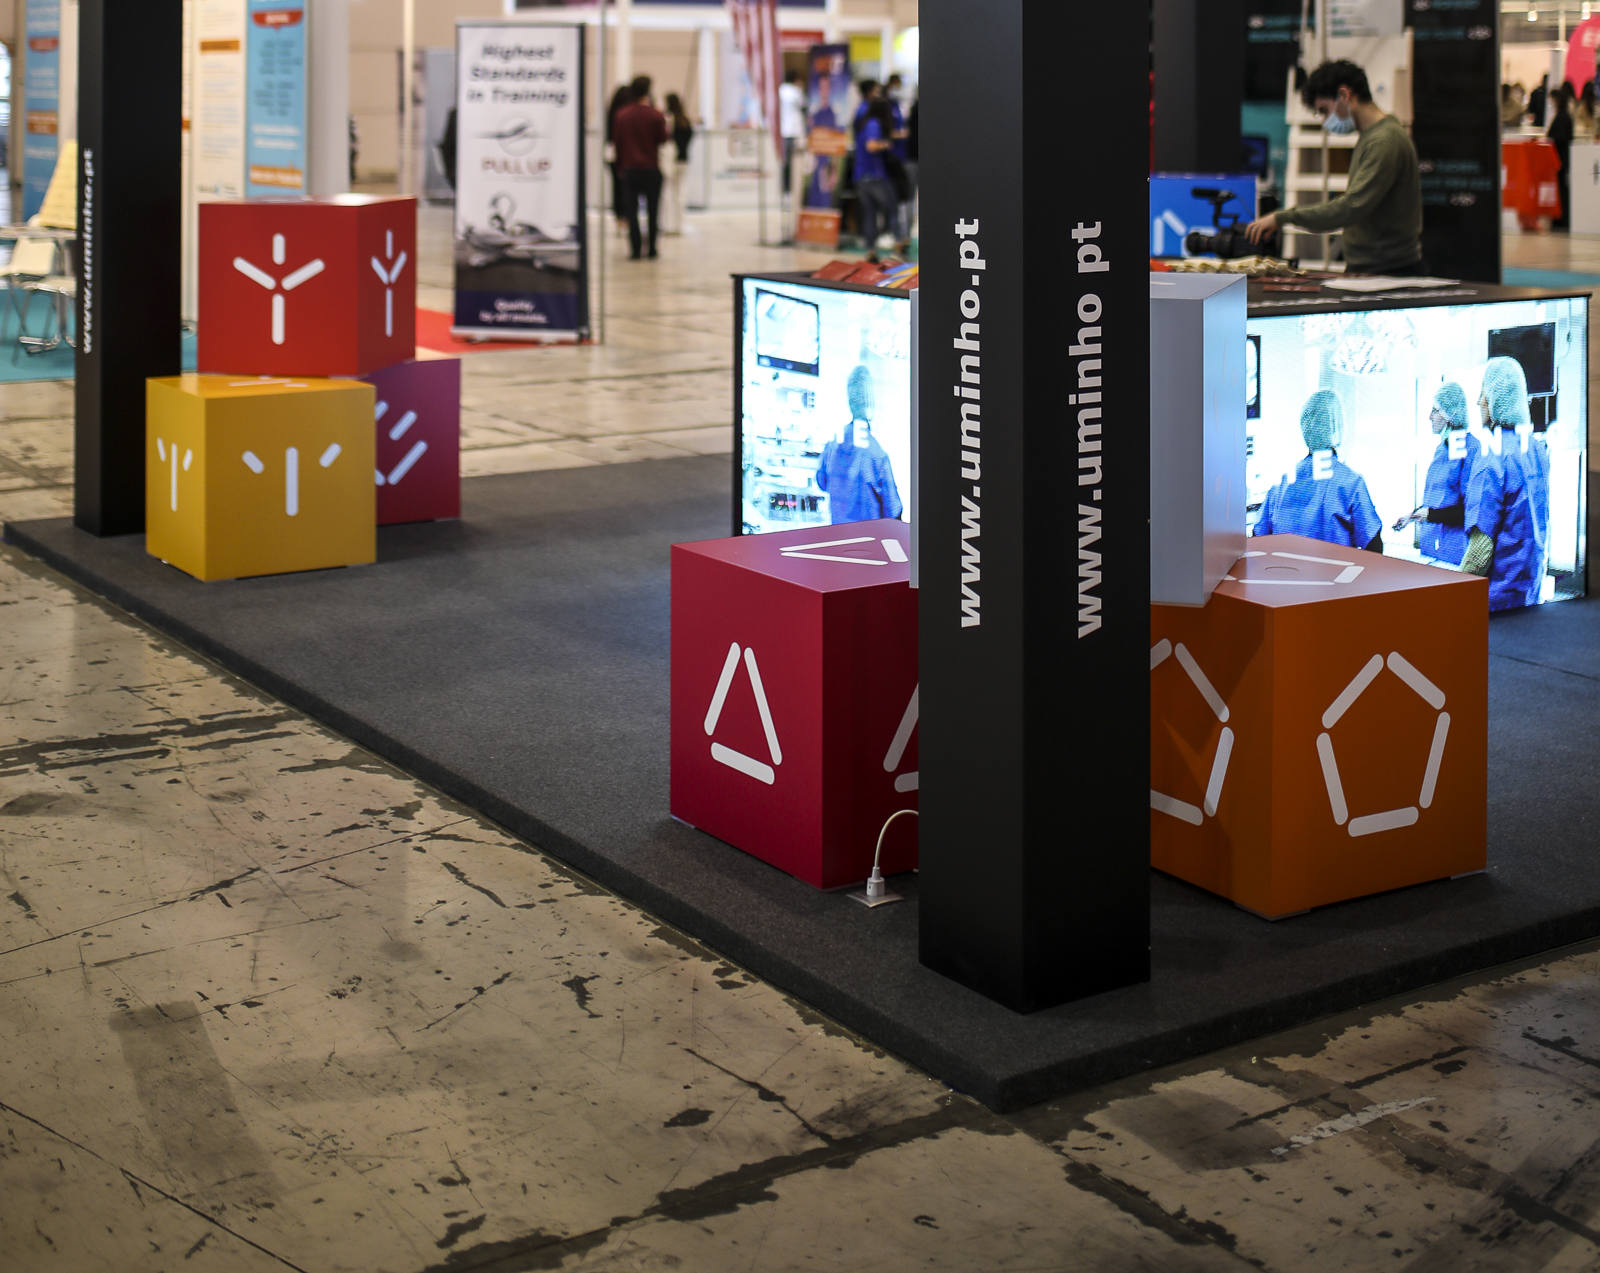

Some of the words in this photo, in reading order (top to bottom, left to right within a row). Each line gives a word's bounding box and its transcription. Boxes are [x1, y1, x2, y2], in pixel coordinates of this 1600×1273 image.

[470, 66, 566, 82] Standards
[483, 45, 553, 63] Highest
[83, 148, 95, 354] www.uminho.pt
[953, 217, 986, 628] www.uminho.pt
